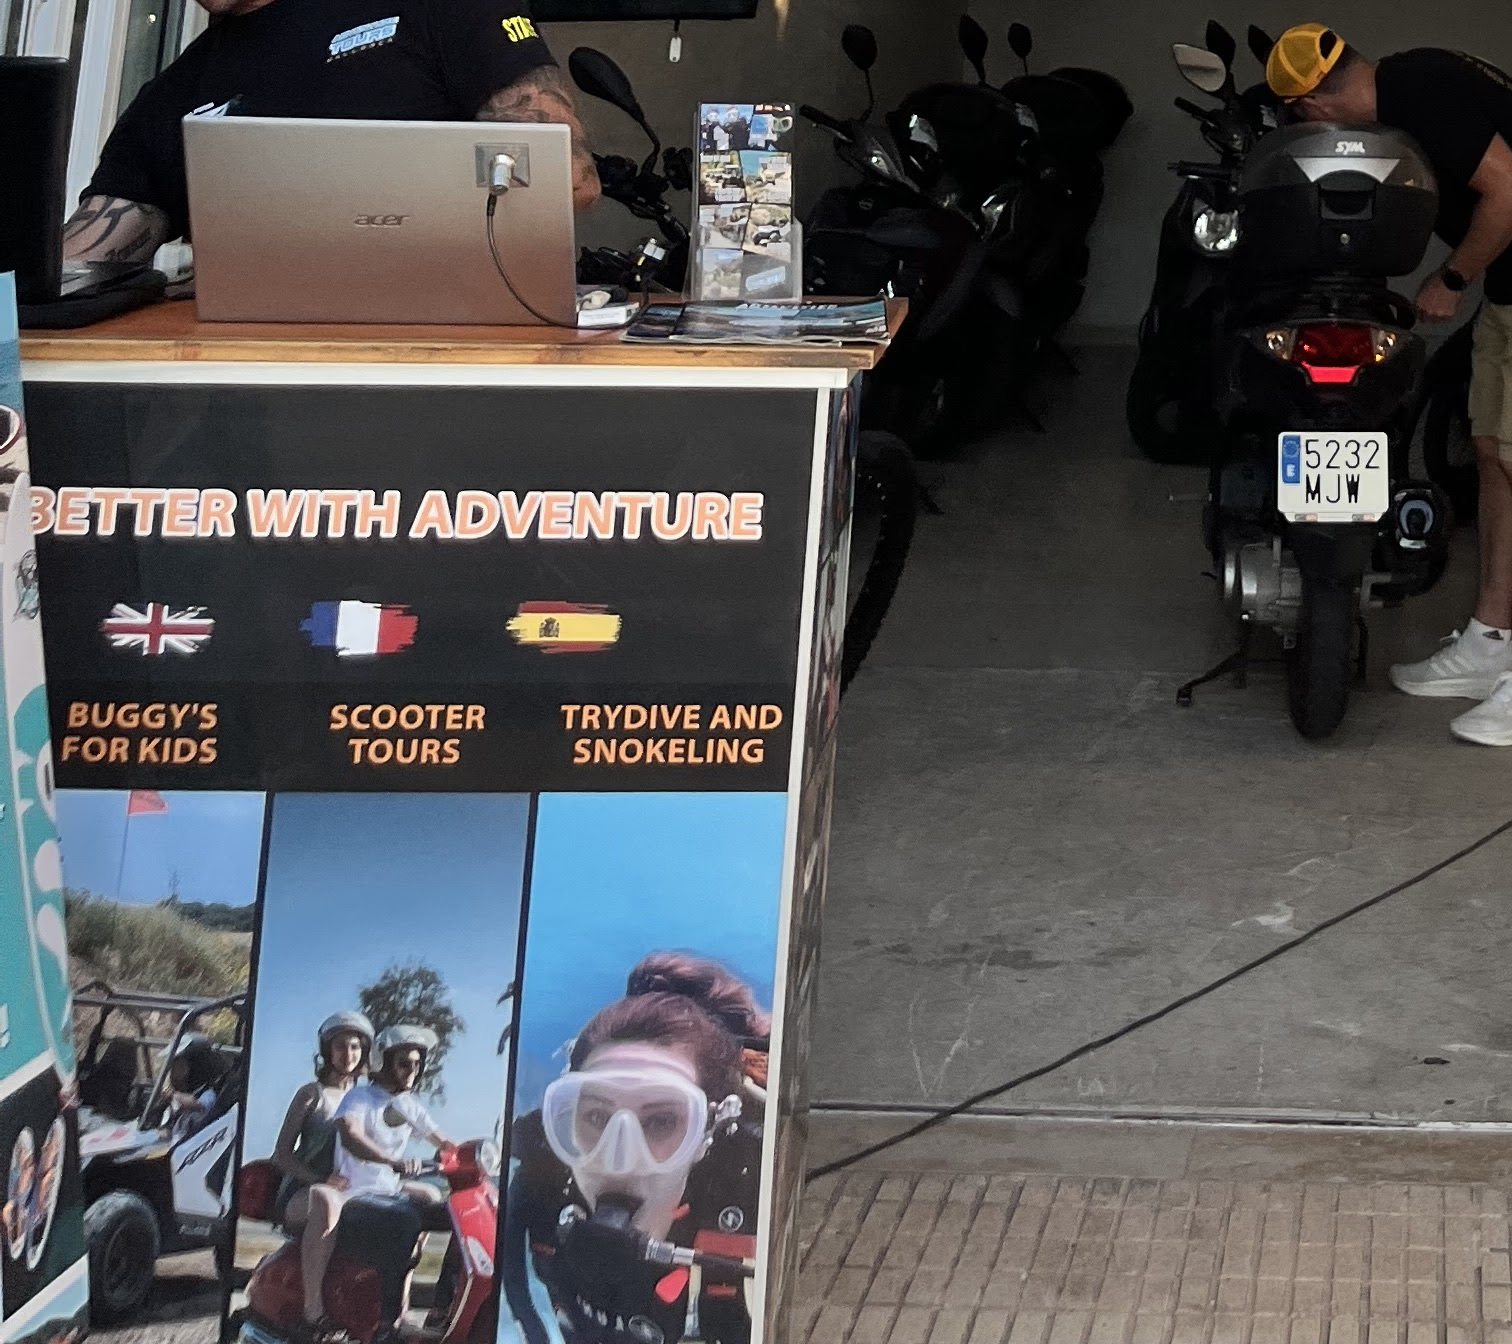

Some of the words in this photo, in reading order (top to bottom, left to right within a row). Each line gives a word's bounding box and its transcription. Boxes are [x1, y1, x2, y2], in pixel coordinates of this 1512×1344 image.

[354, 214, 410, 226] acer
[1305, 438, 1380, 470] 5232
[1286, 463, 1296, 478] E
[1305, 473, 1361, 504] MJW
[30, 486, 236, 539] BETTER
[246, 488, 402, 540] WITH
[408, 489, 765, 541] ADVENTURE
[67, 702, 218, 731] BUGGY'S
[329, 703, 487, 731] SCOOTER
[560, 703, 701, 731] TRYDIVE
[709, 703, 784, 731] AND
[61, 736, 129, 762] FOR
[138, 737, 218, 764] KIDS
[348, 738, 461, 765] TOURS
[572, 738, 765, 765] SNOKELING
